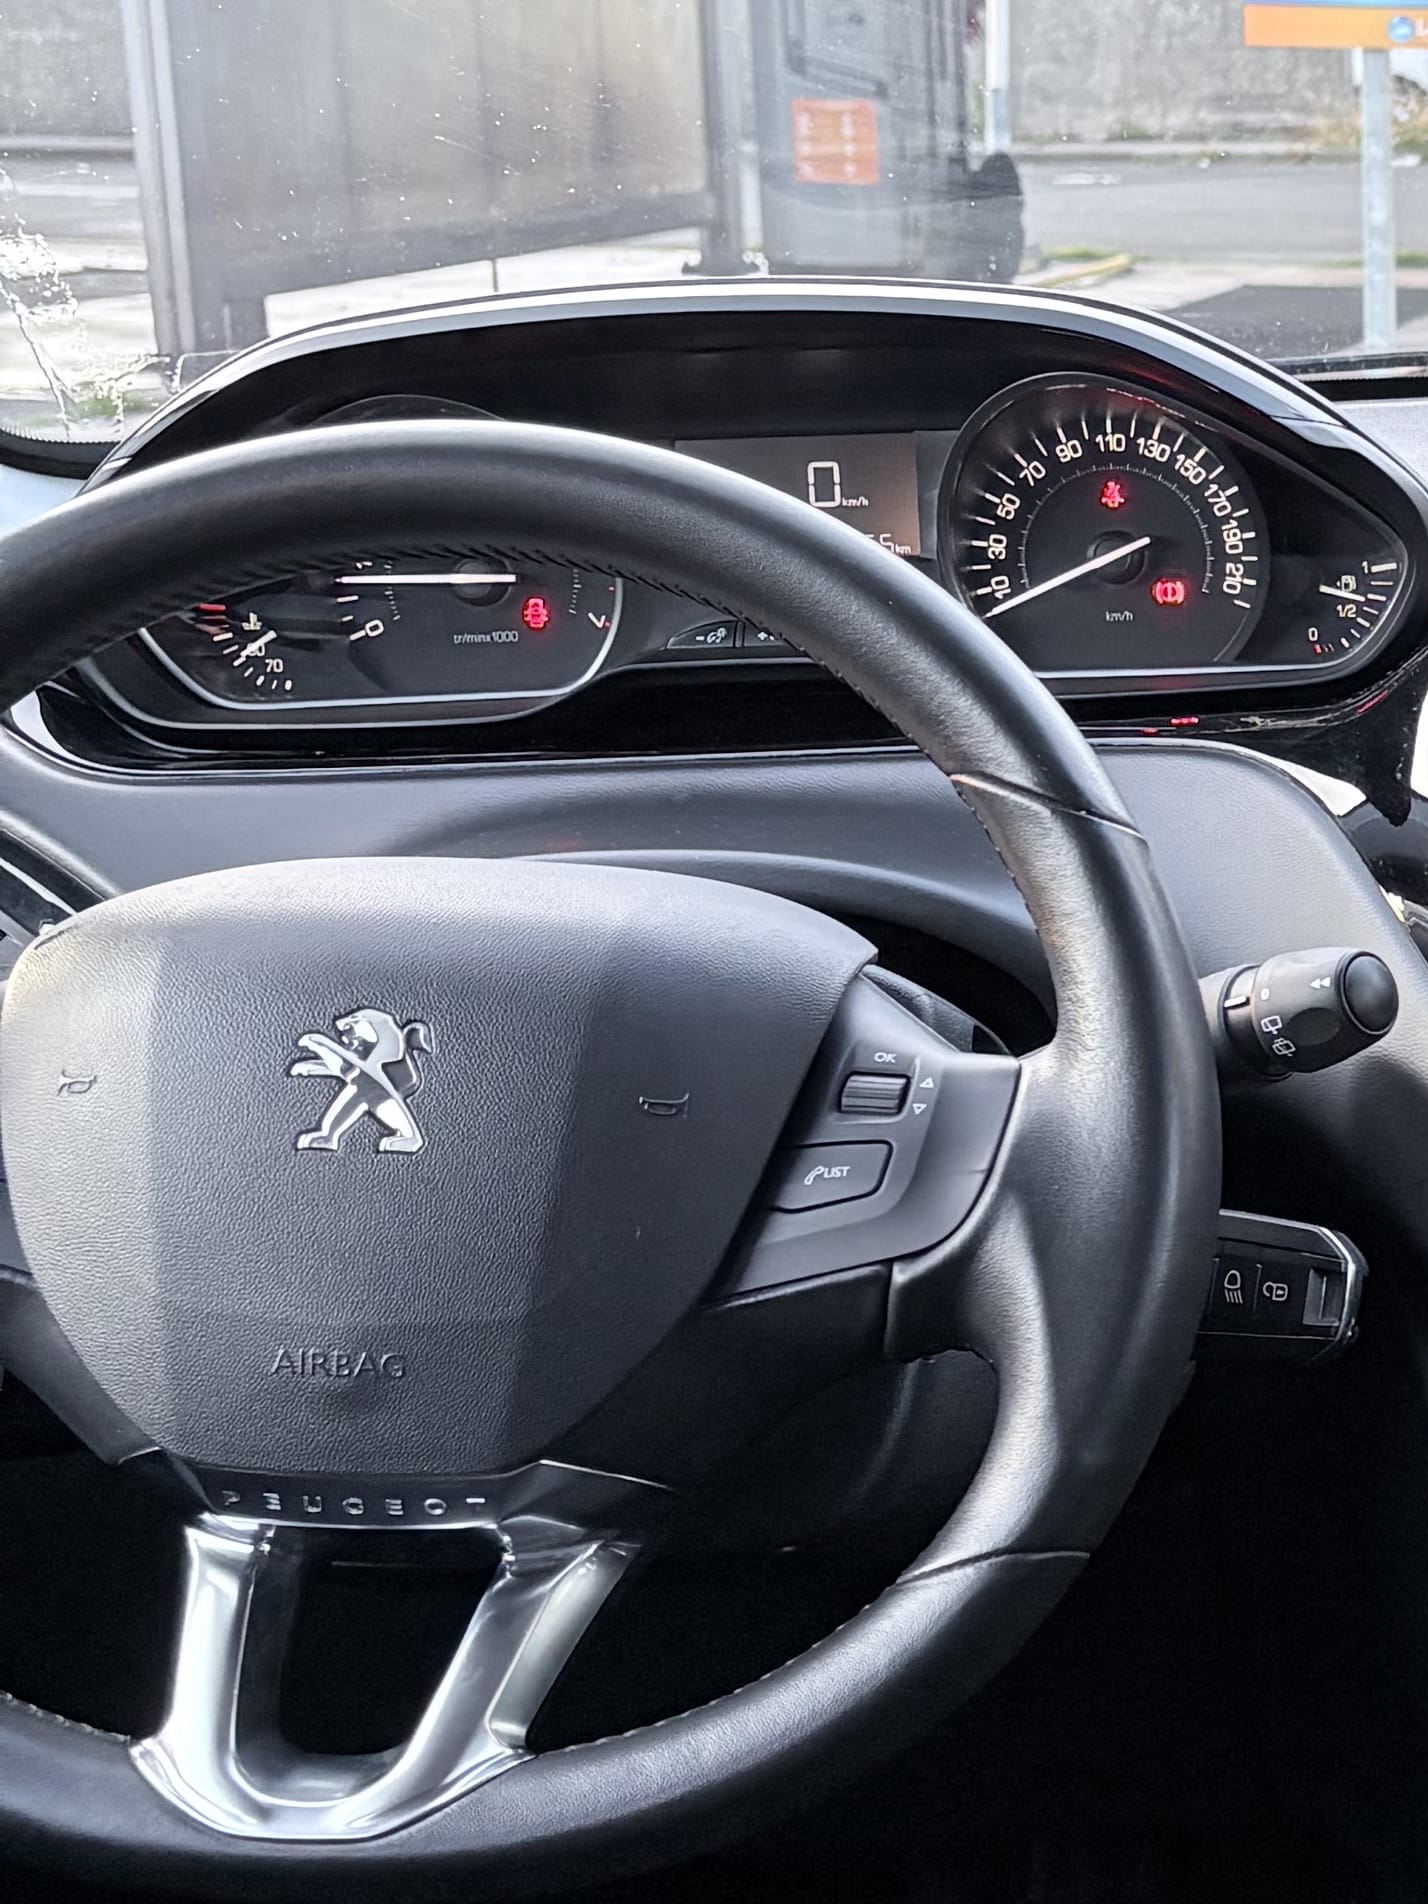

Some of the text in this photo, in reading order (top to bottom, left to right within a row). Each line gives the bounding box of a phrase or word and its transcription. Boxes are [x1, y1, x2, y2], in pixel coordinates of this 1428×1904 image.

[1055, 439, 1083, 464] 90
[1095, 434, 1126, 454] 110
[1136, 436, 1172, 463] 130
[1018, 460, 1047, 487] 70
[1173, 453, 1207, 485] 150
[807, 461, 869, 508] 0 km/h
[996, 493, 1021, 520] 50
[1203, 483, 1232, 518] 170
[988, 533, 1008, 560] 30
[1220, 519, 1244, 555] 190
[1223, 561, 1245, 595] 210
[1361, 560, 1369, 574] 1
[990, 575, 1011, 599] 10
[1105, 610, 1134, 623] km/h
[1336, 603, 1357, 619] 1/2
[1308, 627, 1319, 642] 0
[265, 658, 283, 673] 70
[874, 1052, 897, 1063] OK
[823, 1165, 851, 1179] LIST
[271, 1347, 406, 1379] AIRBAG
